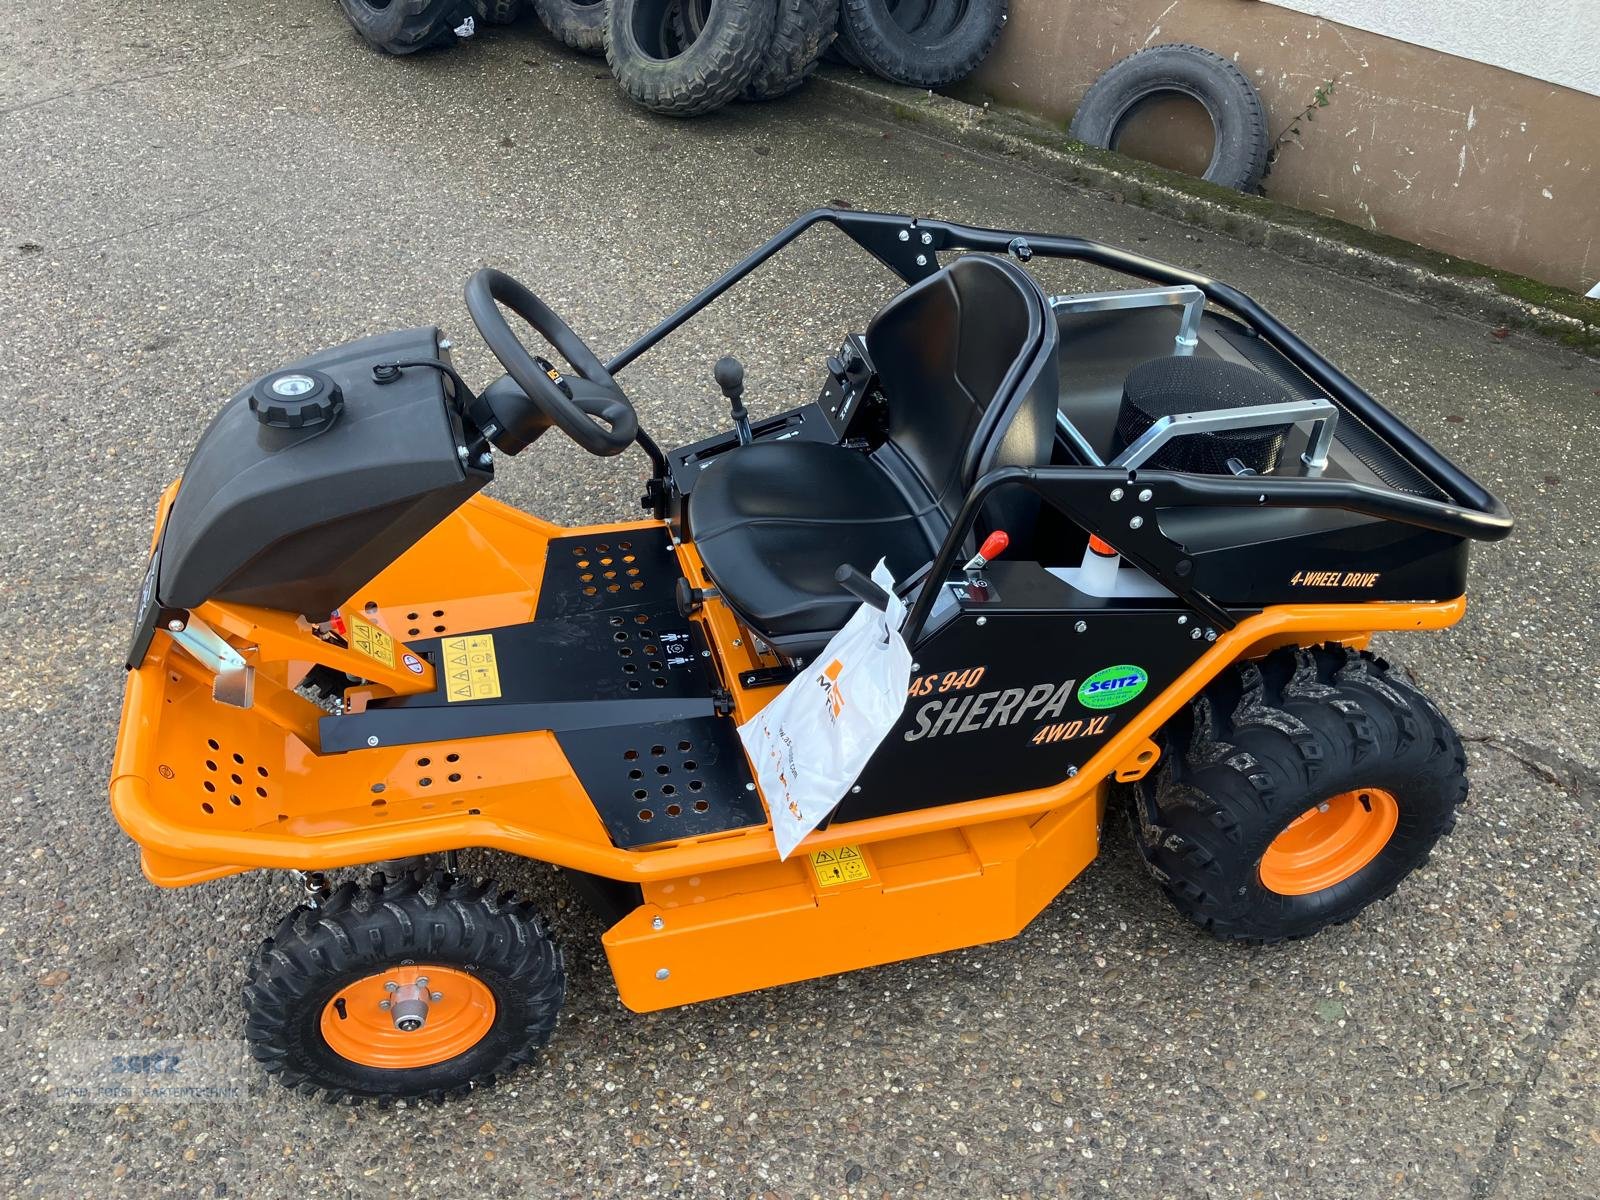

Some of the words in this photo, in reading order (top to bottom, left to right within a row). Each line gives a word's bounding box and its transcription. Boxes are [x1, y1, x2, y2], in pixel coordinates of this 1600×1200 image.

[1290, 571, 1342, 587] 4-WHEEL
[1342, 573, 1380, 588] DRIVE
[907, 675, 939, 697] AS
[939, 666, 986, 693] 940
[1088, 674, 1139, 693] SEITZ
[903, 679, 1077, 742] SHERPA
[1031, 720, 1083, 746] 4WD
[1080, 715, 1110, 738] XL
